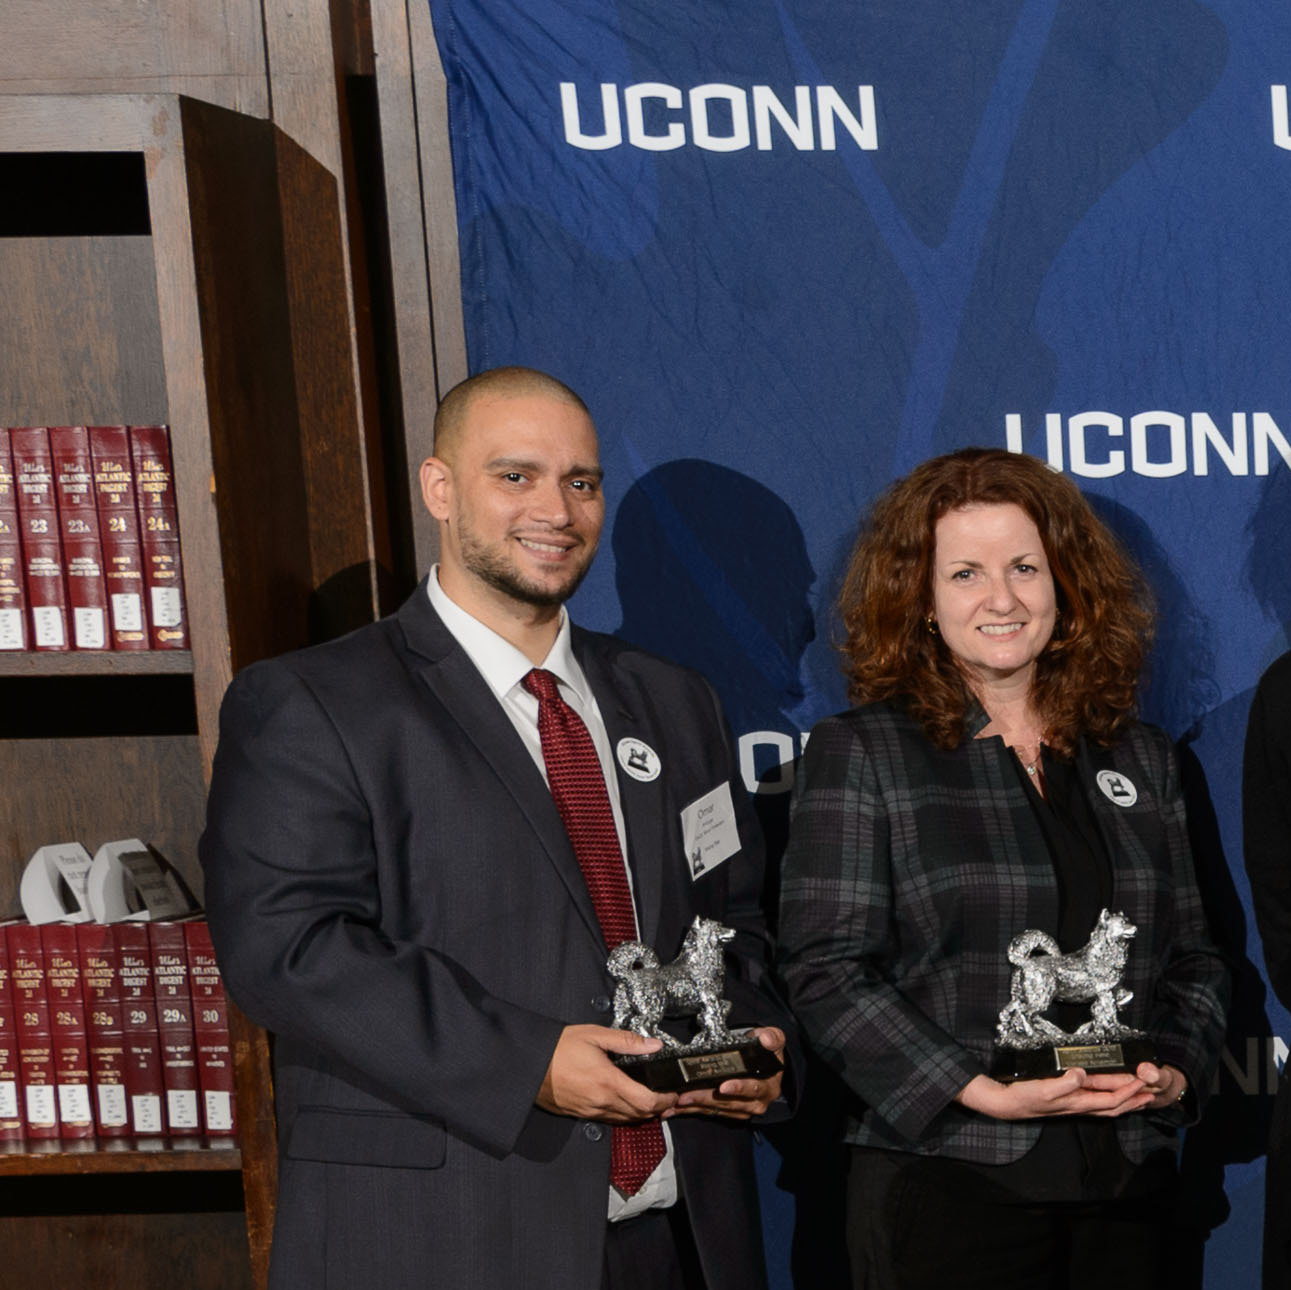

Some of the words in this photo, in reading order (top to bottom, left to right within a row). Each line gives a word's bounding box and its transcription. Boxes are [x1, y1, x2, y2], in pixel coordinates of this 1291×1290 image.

[560, 83, 878, 151] UCONN
[31, 519, 47, 533] 23
[109, 518, 126, 532] 24
[24, 1013, 38, 1026] 28
[130, 1011, 147, 1024] 29
[203, 1010, 218, 1023] 30
